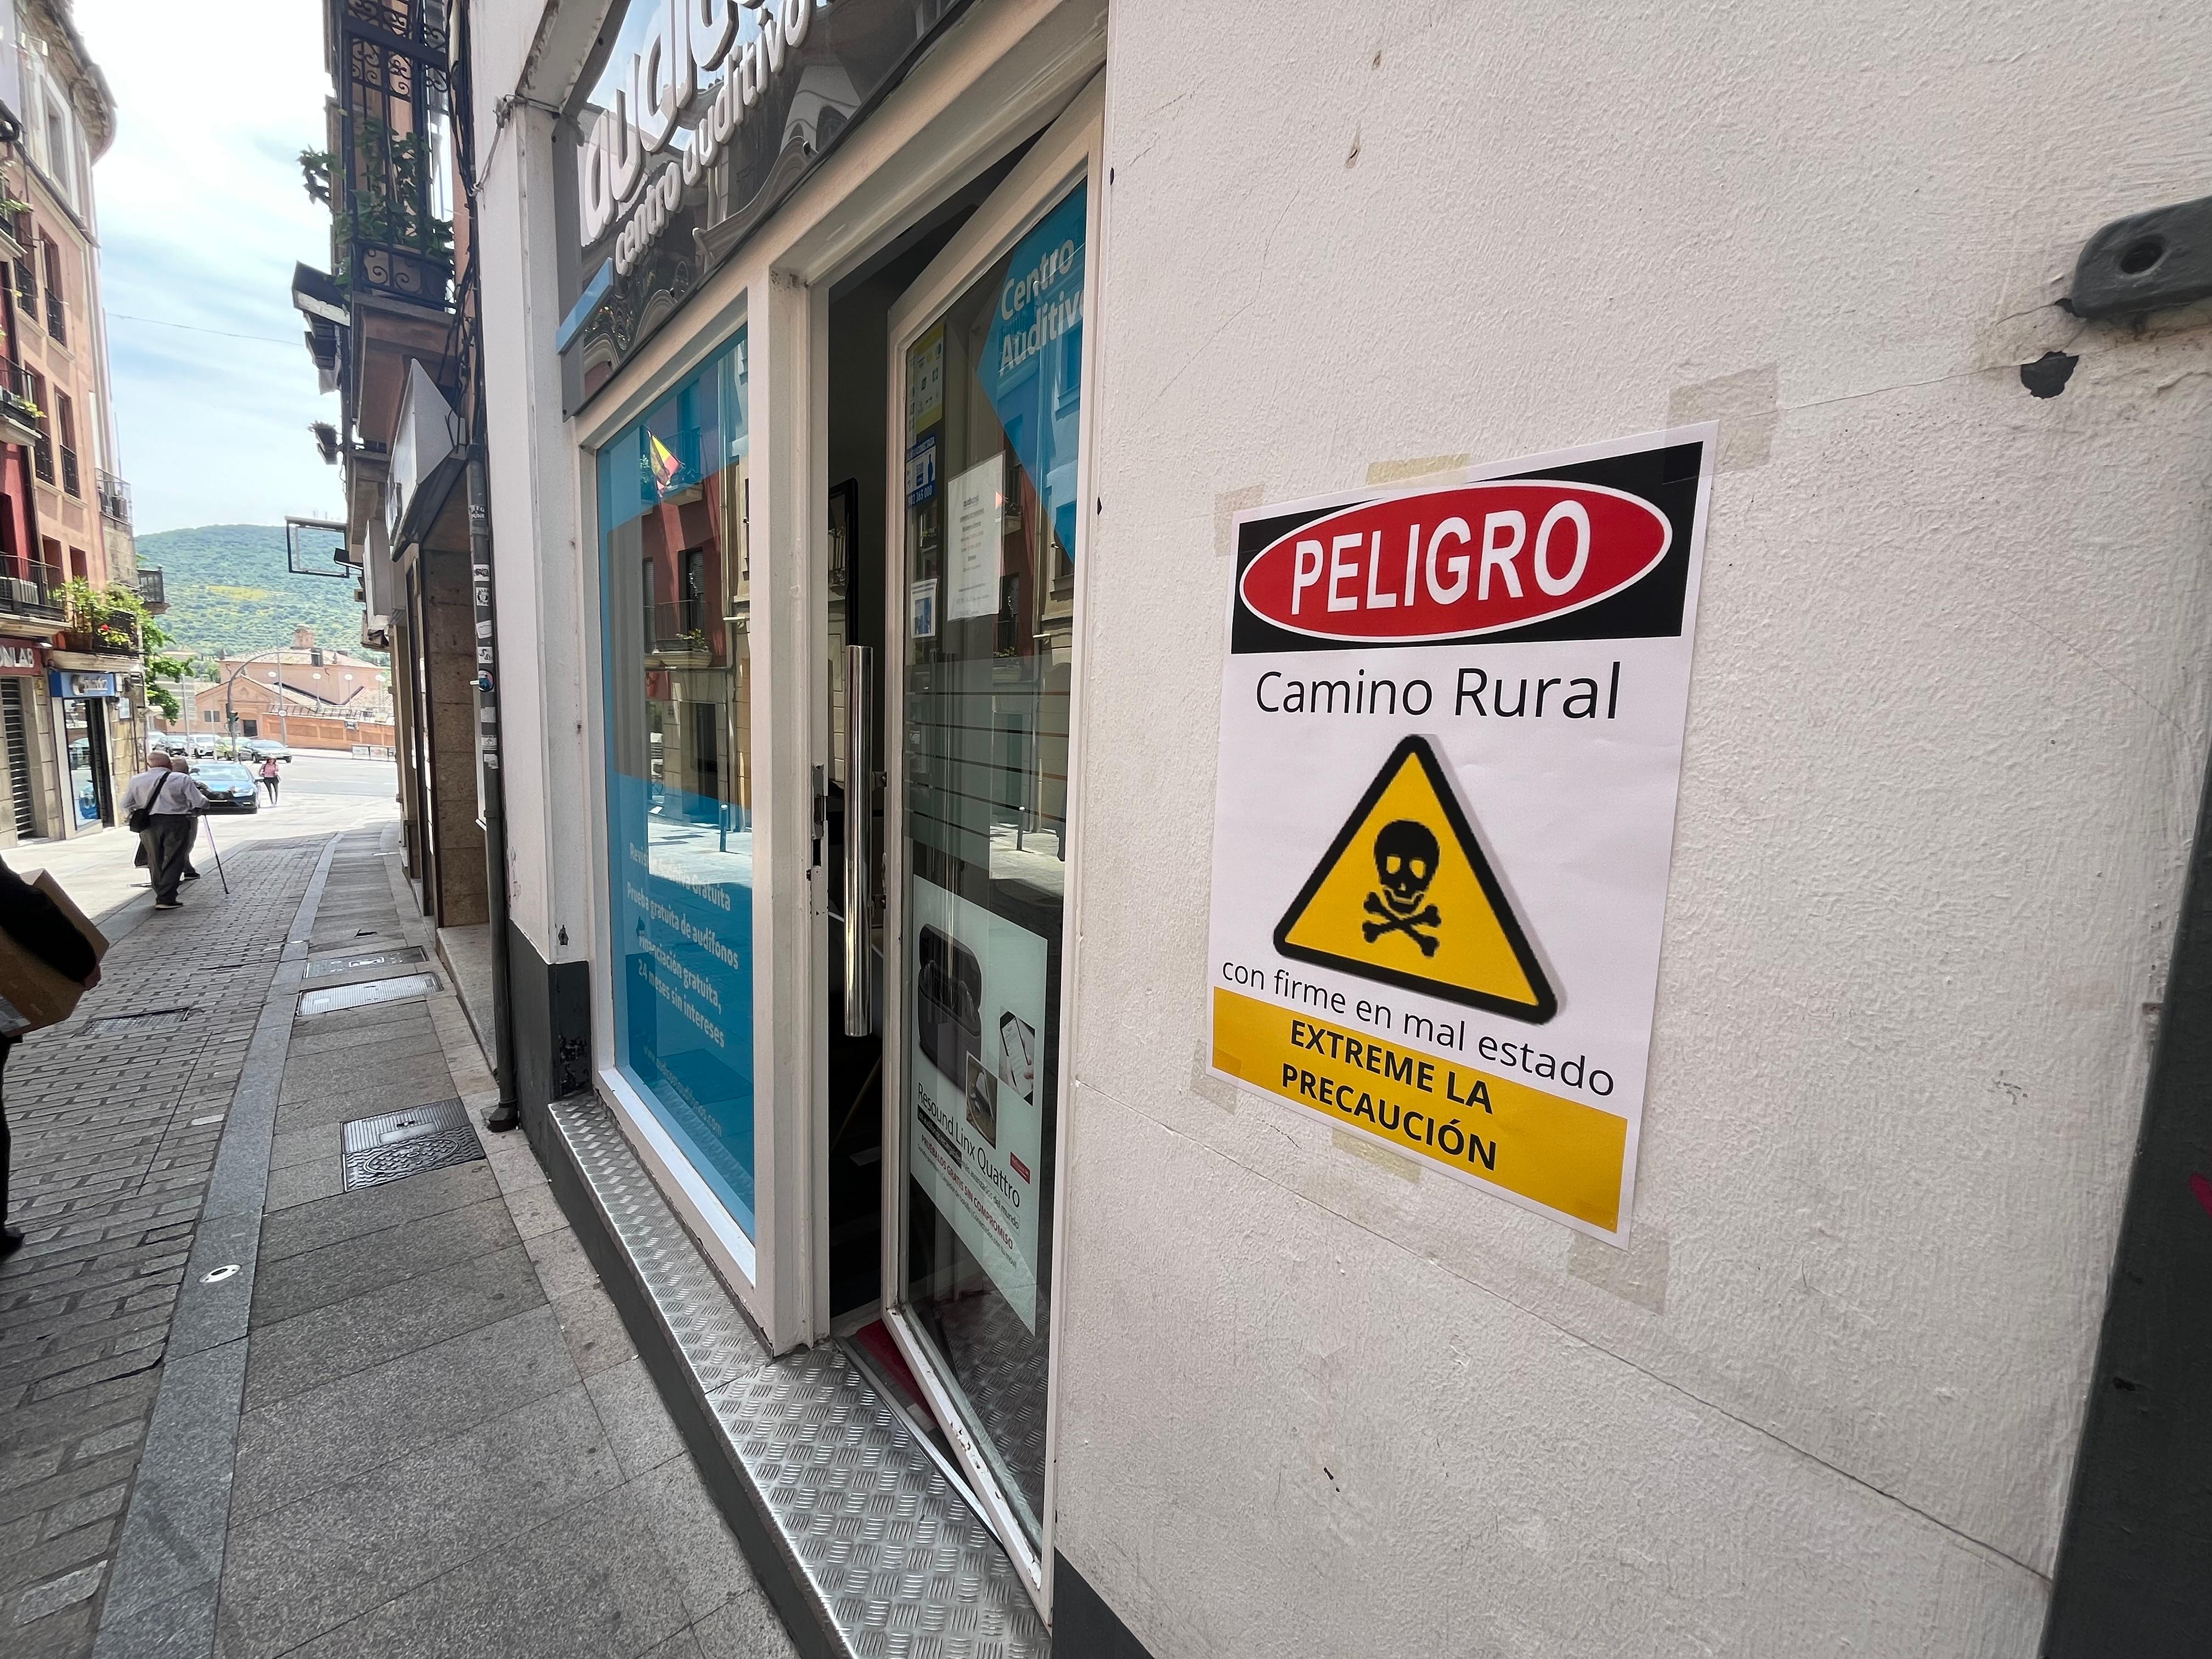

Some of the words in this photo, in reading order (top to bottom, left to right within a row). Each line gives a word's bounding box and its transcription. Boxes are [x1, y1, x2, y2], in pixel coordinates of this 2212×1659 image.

[616, 162, 681, 275] centro
[683, 0, 810, 187] auditivo
[1001, 239, 1074, 320] Centro
[999, 289, 1084, 377] Auditiv
[1291, 500, 1592, 616] PELIGRO
[1256, 669, 1432, 716] Camino
[1455, 662, 1621, 720] Rural
[627, 881, 650, 911] Prueba
[650, 900, 680, 930] gratuita
[681, 913, 691, 939] de
[639, 931, 682, 979] Financiación
[684, 968, 721, 1015] gratuita,
[639, 958, 647, 980] 24
[649, 971, 670, 1000] meses
[672, 987, 682, 1012] sin
[684, 994, 725, 1048] intereses
[1222, 961, 1265, 990] con
[1274, 968, 1346, 1014] firme
[1356, 999, 1391, 1029] en
[1403, 1011, 1465, 1052] mal
[1478, 1035, 1615, 1097] estado
[1290, 1019, 1436, 1093] EXTREME
[1446, 1071, 1494, 1115] LA
[918, 1081, 953, 1137] Resound
[956, 1122, 975, 1161] Linx
[978, 1147, 1020, 1208] Quattro
[1282, 1063, 1497, 1171] PRECAUCIÓN
[947, 1165, 964, 1190] GRATIS
[964, 1185, 973, 1203] SIN
[974, 1197, 1013, 1250] COMPROMISO
[1001, 1205, 1019, 1230] mundo
